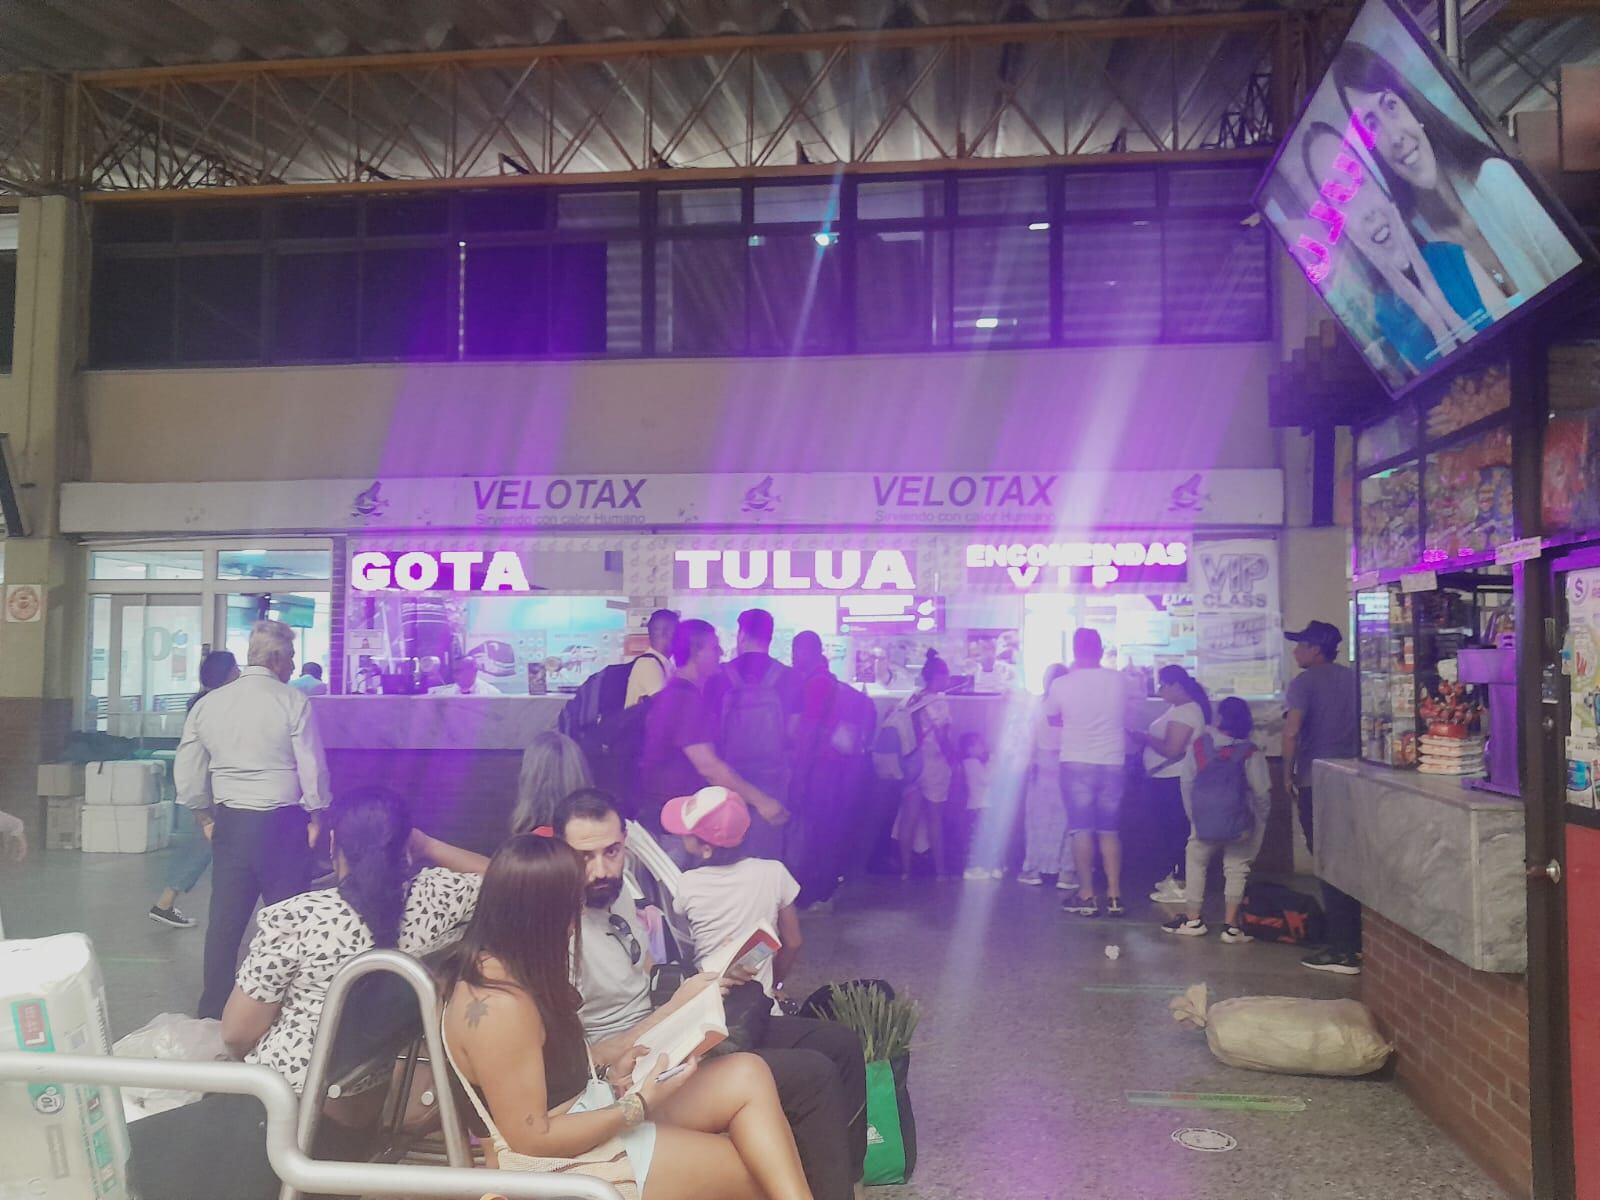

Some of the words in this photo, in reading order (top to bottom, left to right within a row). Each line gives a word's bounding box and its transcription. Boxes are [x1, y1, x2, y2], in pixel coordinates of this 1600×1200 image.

[473, 478, 647, 510] VELOTAX
[873, 475, 1057, 507] VELOTAX
[352, 551, 530, 591] GOTA
[674, 550, 916, 589] TULUA
[1200, 552, 1270, 593] VIP
[1202, 593, 1268, 609] CLASS
